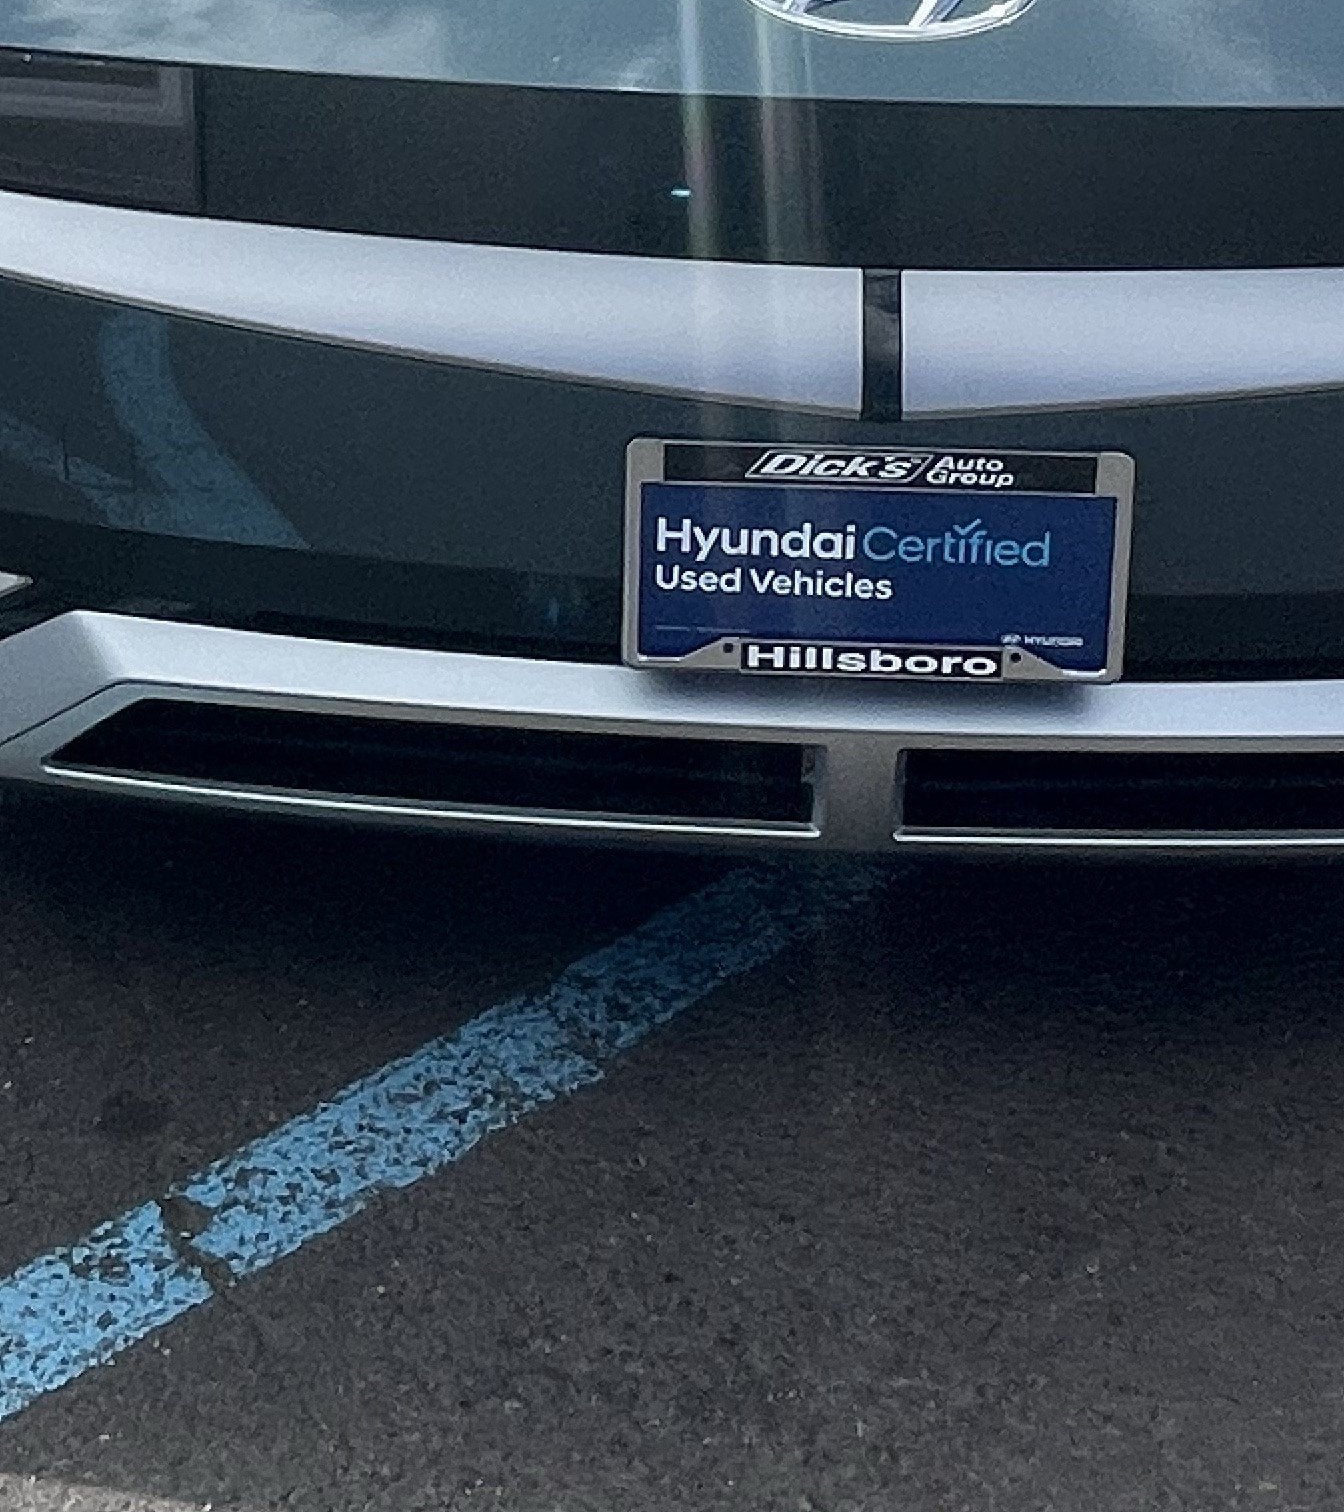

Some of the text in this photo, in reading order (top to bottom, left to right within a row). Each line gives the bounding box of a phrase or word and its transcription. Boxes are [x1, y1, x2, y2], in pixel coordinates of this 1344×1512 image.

[926, 469, 1014, 488] Group
[932, 456, 1004, 472] Auto
[656, 517, 1051, 567] Hyundai Certified
[655, 565, 893, 599] Used Vehicles
[747, 645, 997, 676] Hillsboro
